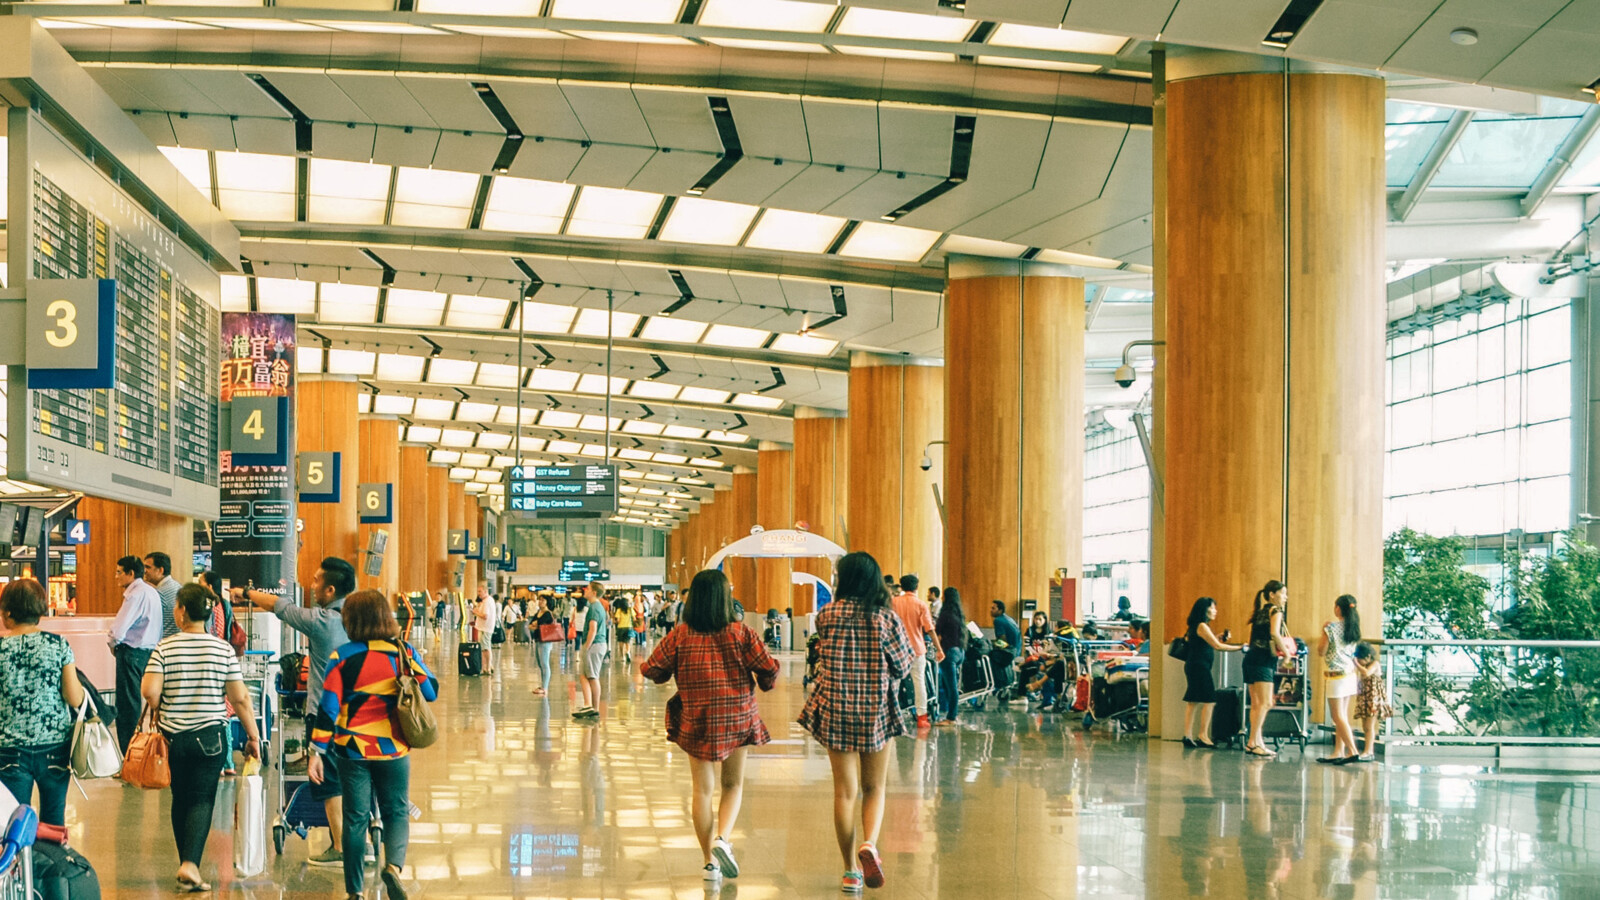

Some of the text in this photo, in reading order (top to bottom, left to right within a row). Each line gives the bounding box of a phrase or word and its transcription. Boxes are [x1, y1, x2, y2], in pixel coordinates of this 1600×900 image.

[112, 192, 174, 257] DEPARTURES
[45, 300, 78, 348] 3
[232, 334, 268, 359] 樟宜
[219, 358, 289, 389] 百万富翁
[242, 409, 265, 440] 4
[307, 461, 324, 485] 5
[557, 485, 582, 493] Changer
[366, 491, 380, 510] 6
[70, 522, 86, 542] 4
[452, 533, 462, 546] 7
[761, 534, 808, 543] CHANGI
[468, 541, 477, 551] 8
[492, 547, 500, 556] 9
